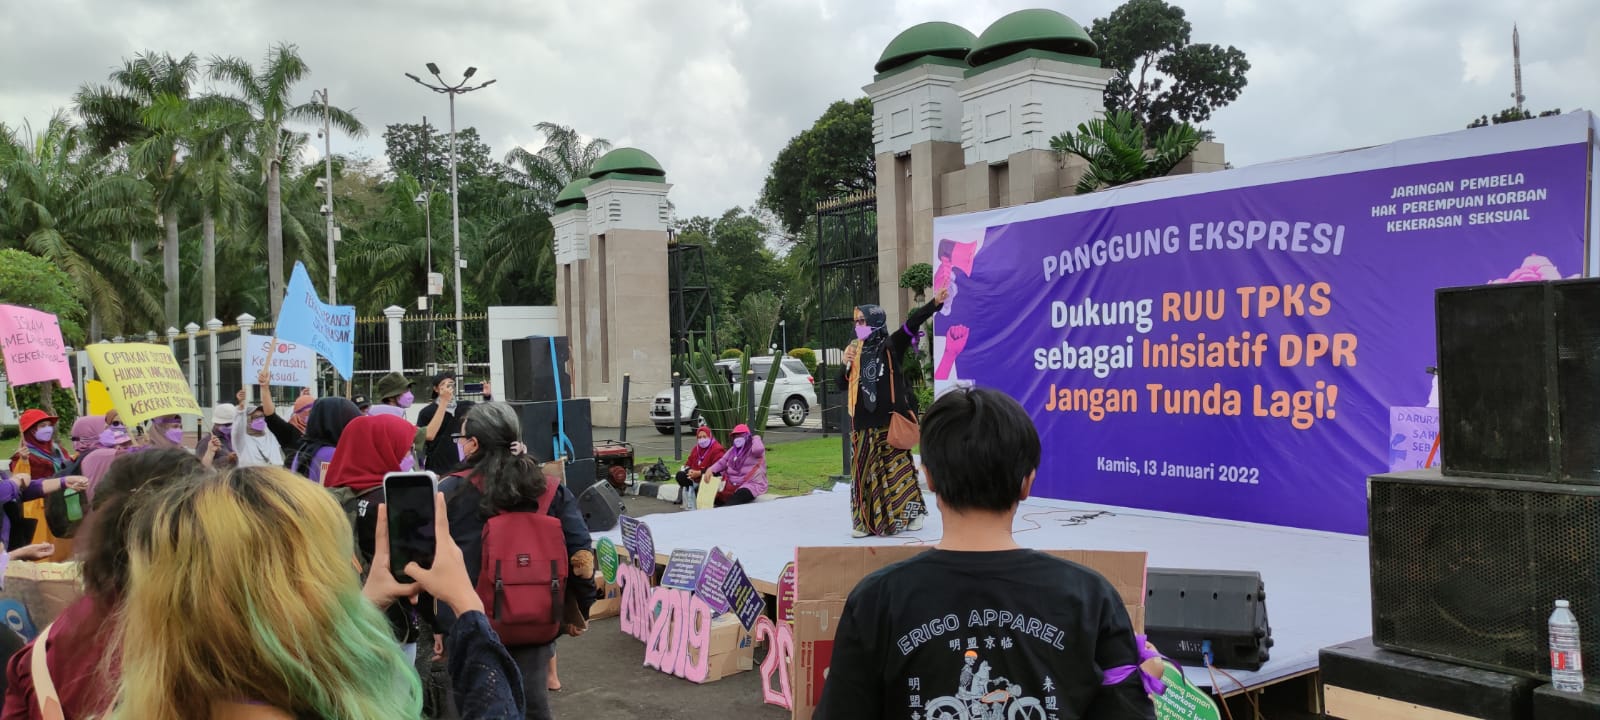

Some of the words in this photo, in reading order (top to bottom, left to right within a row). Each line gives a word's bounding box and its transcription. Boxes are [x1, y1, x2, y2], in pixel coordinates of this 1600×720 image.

[1371, 204, 1397, 217] HAK
[1402, 195, 1484, 214] PEREMPUAN
[1487, 188, 1547, 206] KORBAN
[1390, 181, 1454, 199] JARINGAN
[1460, 173, 1524, 191] PEMBELA
[1386, 214, 1462, 232] KEKERASAN
[1468, 208, 1530, 225] SEKSUAL
[1042, 225, 1180, 282] PANGGUNG
[1189, 220, 1345, 256] EKSPRESI
[1051, 297, 1153, 333] Dukung
[1162, 288, 1225, 322] RUU
[1236, 281, 1332, 318] TPKS
[252, 355, 307, 368] Keerasan
[1034, 336, 1133, 378] sebagai
[1142, 332, 1268, 368] Inisiatif
[1279, 333, 1358, 367] DPR
[1045, 384, 1138, 421] Jangan
[1146, 382, 1241, 416] Tunda
[1253, 380, 1338, 430] Lagi!
[1097, 456, 1140, 476] Kamis,
[1144, 460, 1157, 475] 13
[1160, 462, 1214, 480] Januari
[1219, 465, 1259, 484] 2022
[643, 586, 711, 684] 2019
[897, 613, 960, 656] ERIGO
[967, 608, 1065, 651] APPAREL
[1185, 691, 1211, 710] paman
